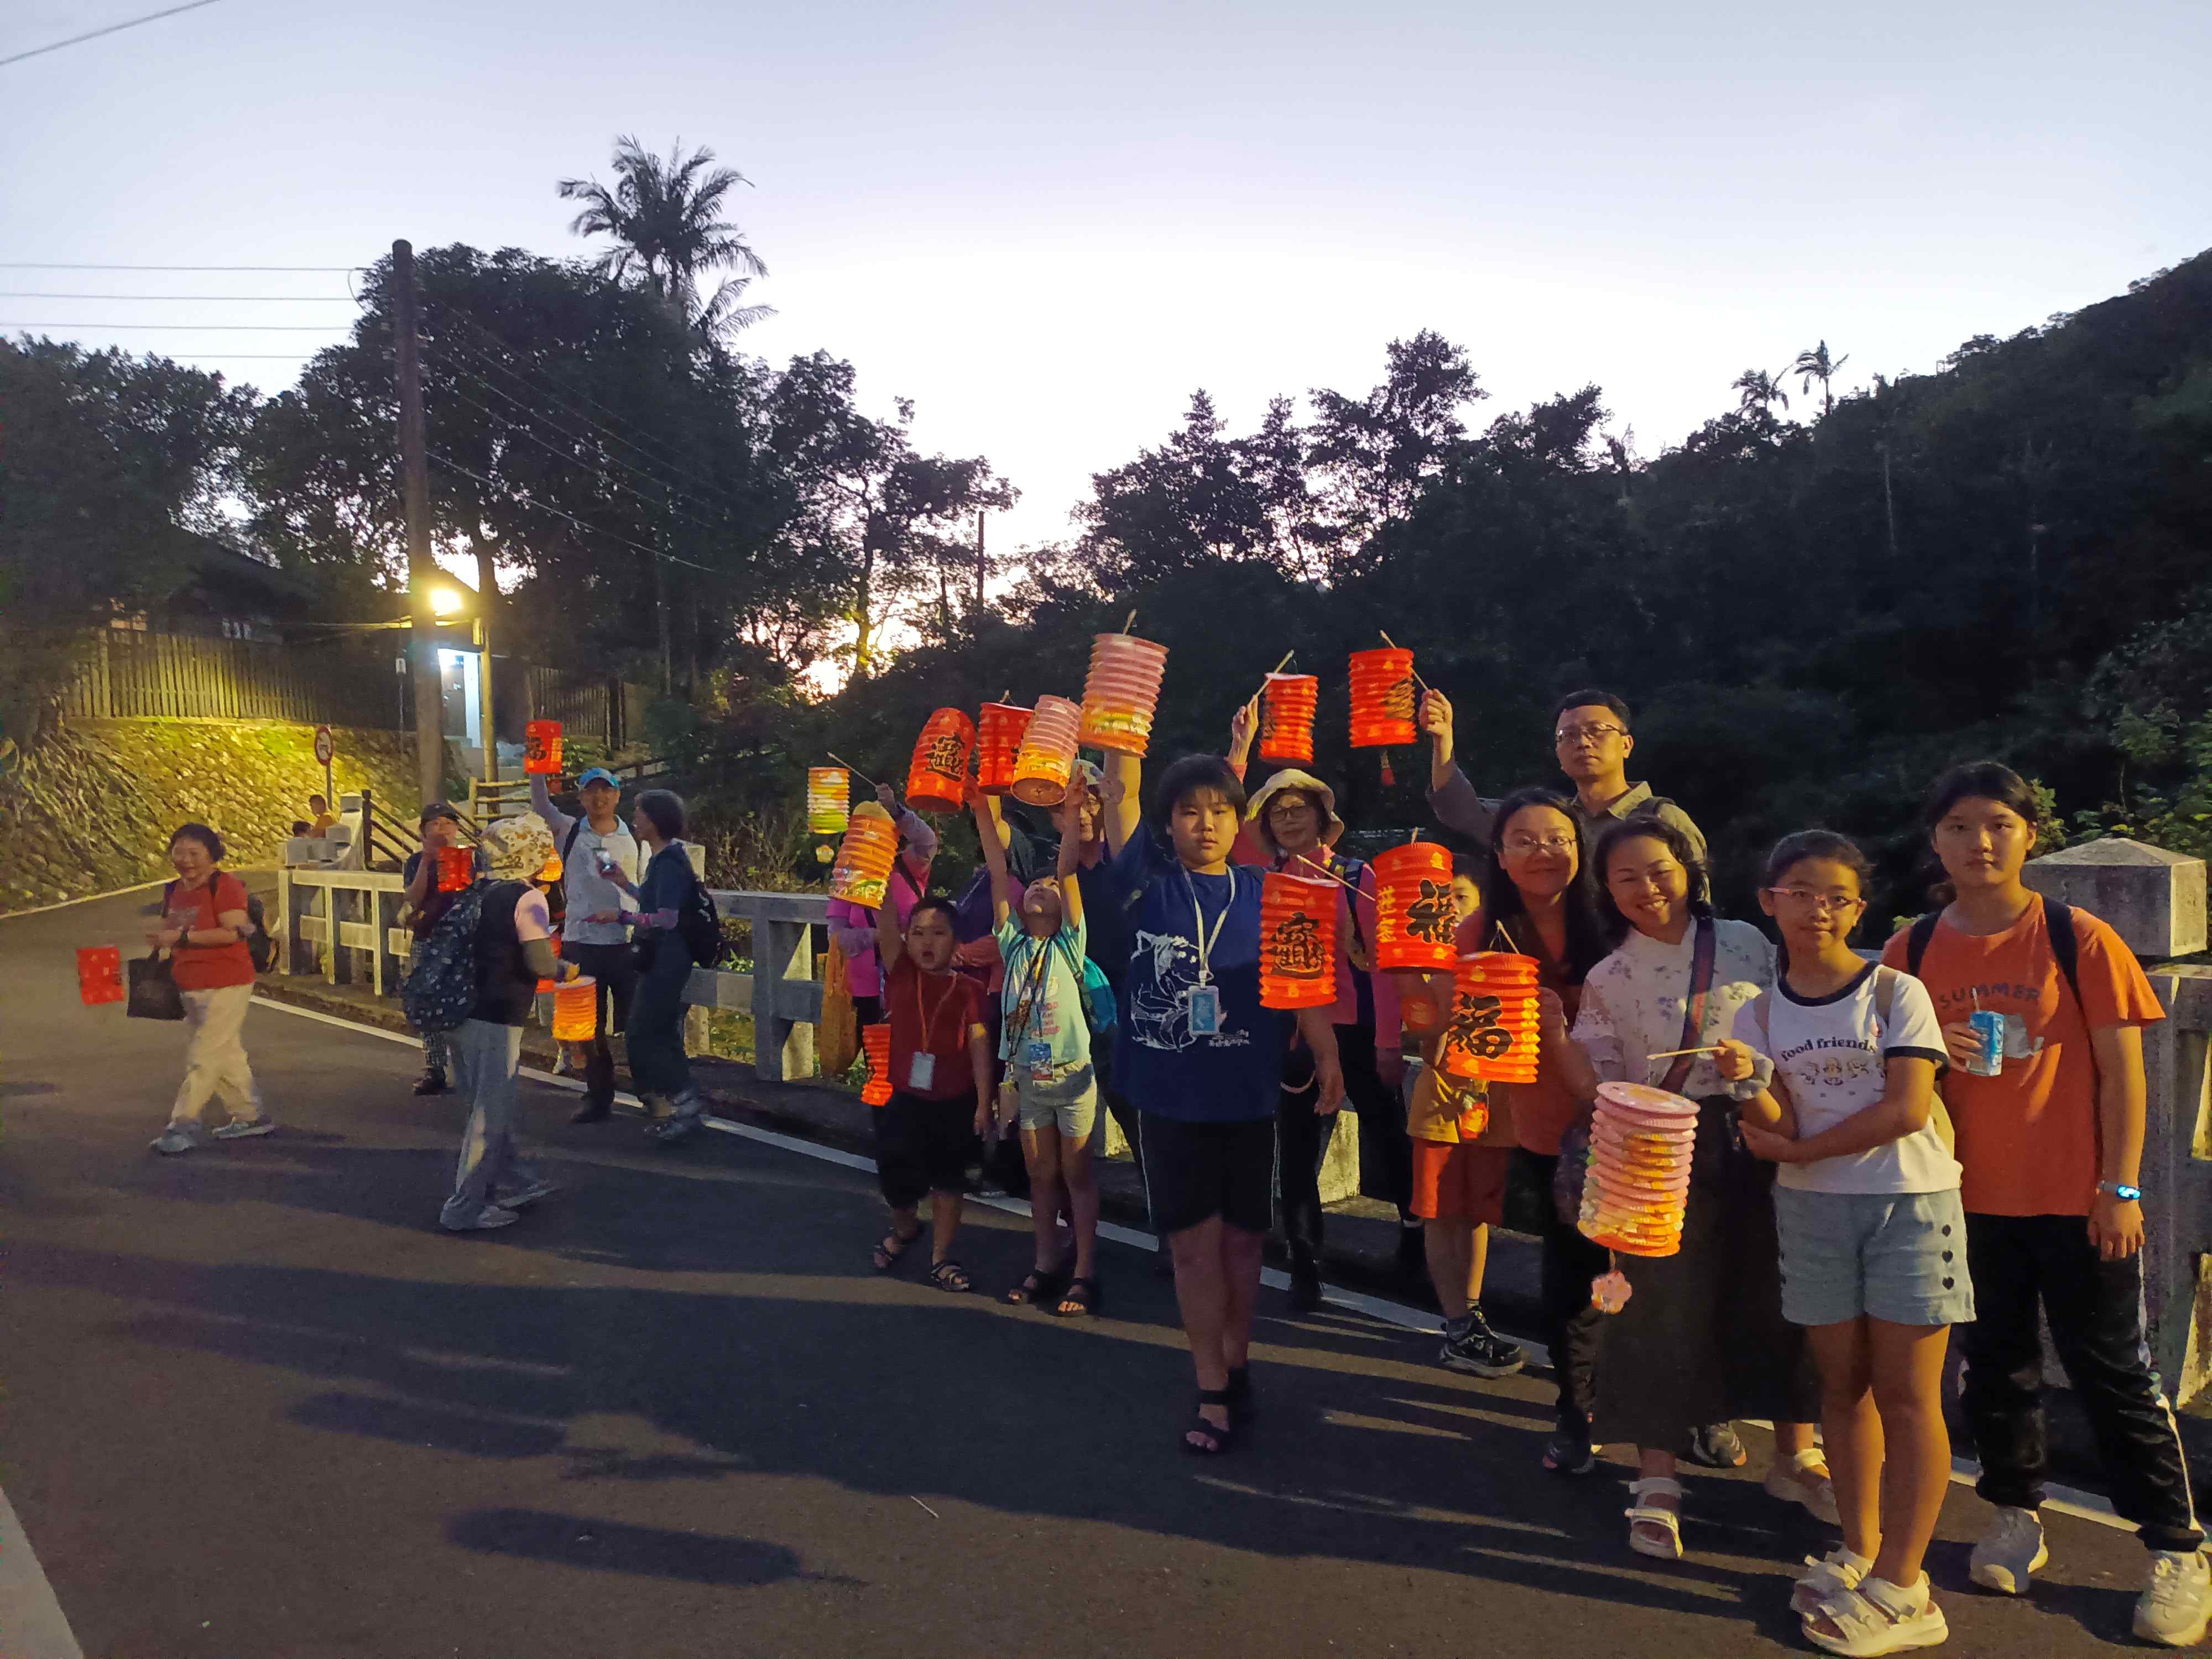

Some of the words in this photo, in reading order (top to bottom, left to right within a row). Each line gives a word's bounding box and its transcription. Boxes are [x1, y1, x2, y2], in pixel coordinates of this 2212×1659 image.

[1939, 982, 2040, 1009] SUMMER
[1781, 1039, 1814, 1062] food
[1816, 1037, 1876, 1053] friends
